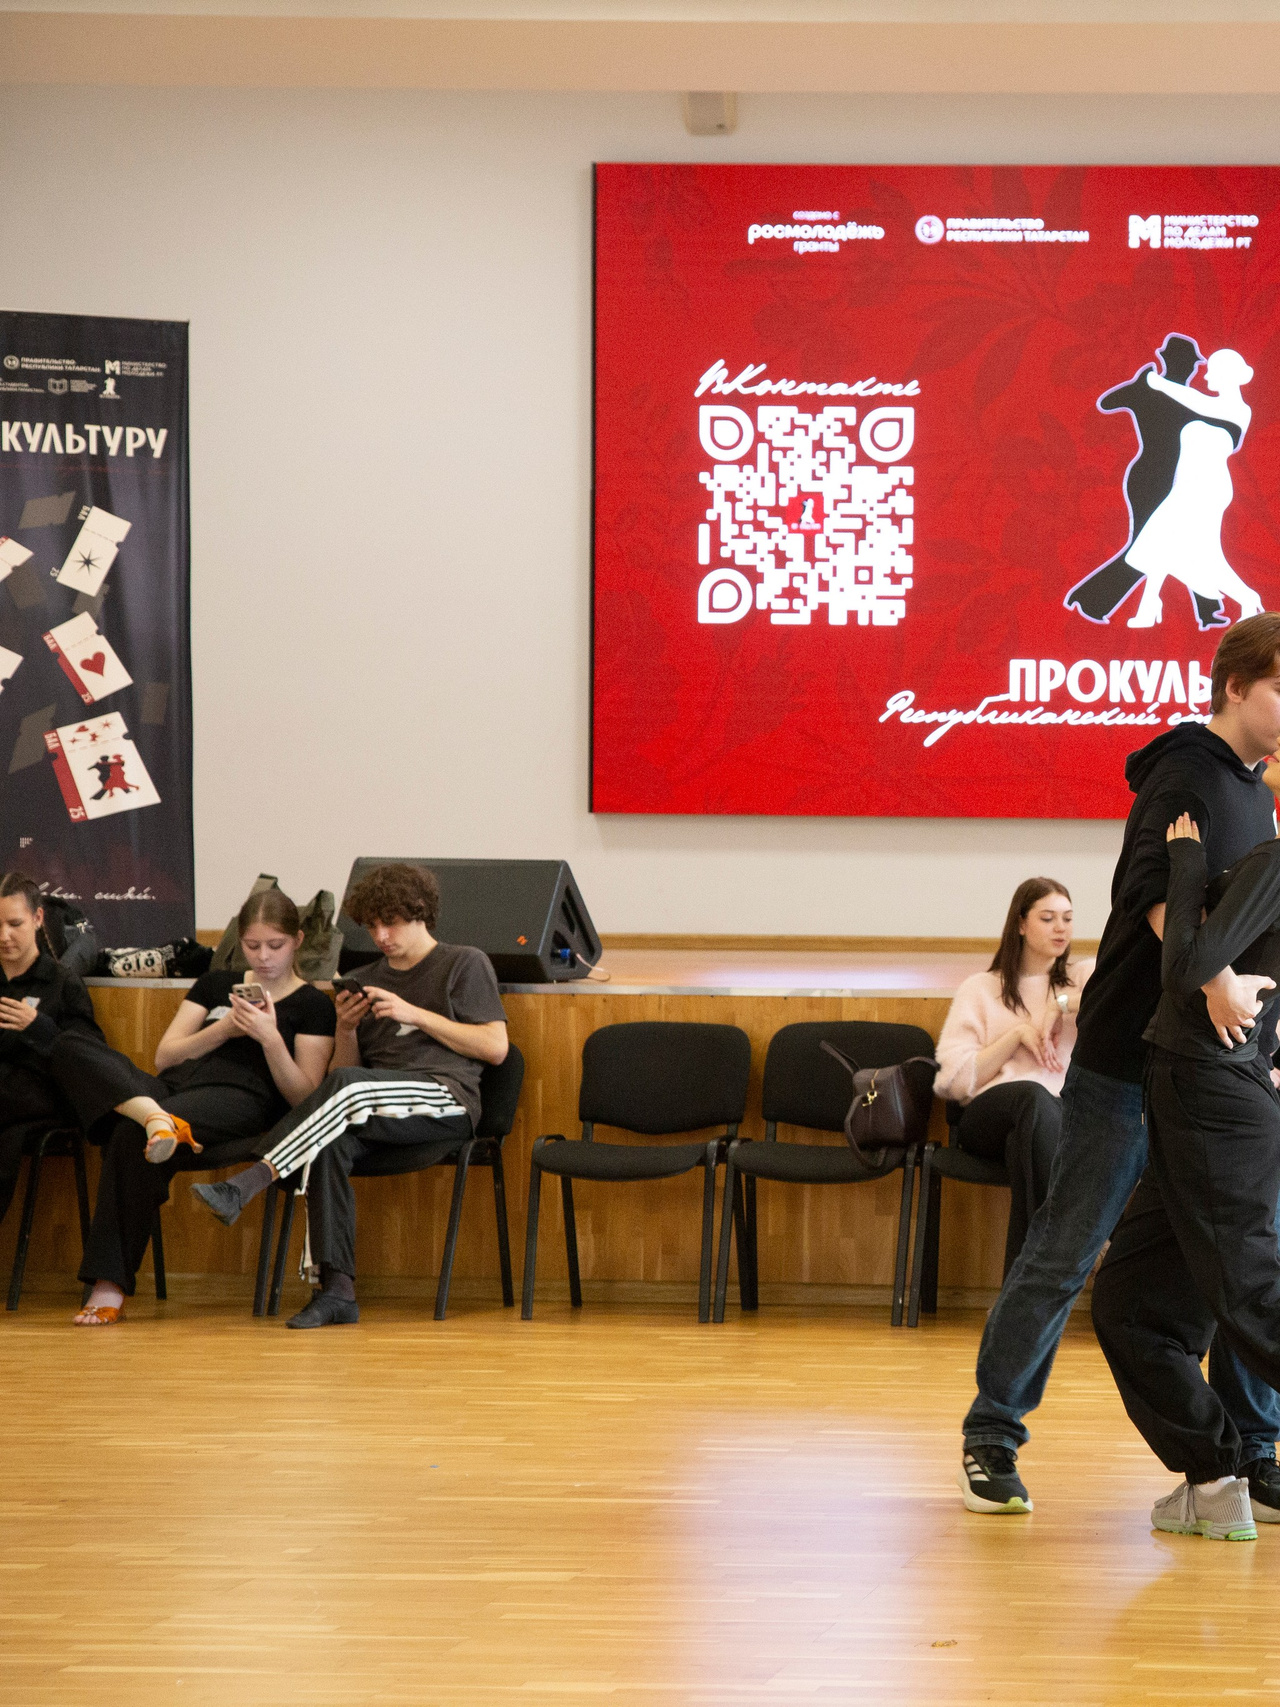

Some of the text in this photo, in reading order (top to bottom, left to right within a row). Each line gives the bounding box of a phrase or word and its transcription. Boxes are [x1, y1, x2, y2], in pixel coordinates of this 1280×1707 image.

[748, 222, 885, 244] росмолодёжь
[694, 359, 921, 397] ВКонтакте
[2, 420, 168, 459] КУЛЬТУРУ
[1009, 658, 1212, 704] ПРОКУЛЬ
[878, 690, 1161, 748] Республиканский
[69, 806, 86, 819] 25
